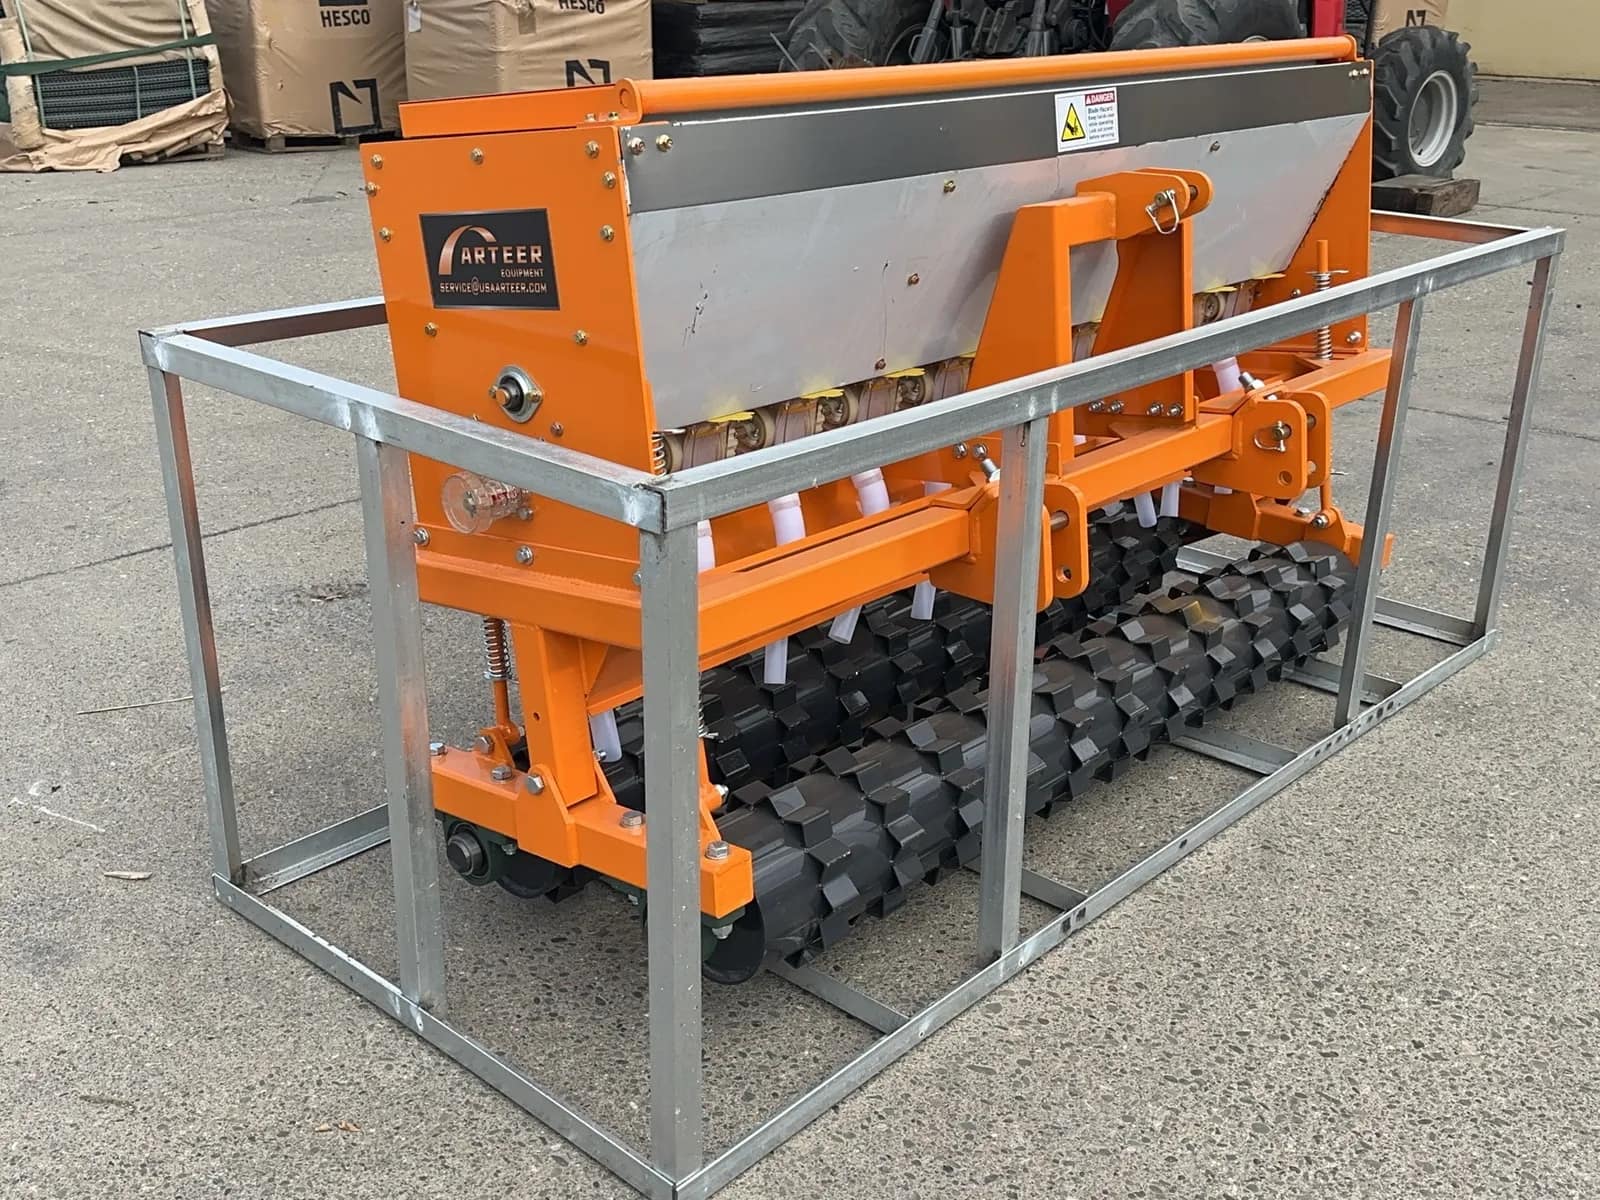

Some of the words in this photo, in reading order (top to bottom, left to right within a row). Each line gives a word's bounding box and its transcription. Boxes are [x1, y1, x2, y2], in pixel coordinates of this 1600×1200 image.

[559, 0, 605, 14] HESCO
[320, 9, 371, 28] HESCO
[1091, 93, 1114, 104] DANGER
[461, 245, 543, 264] ARTEER
[500, 268, 544, 277] EQUIPMENT
[440, 277, 547, 295] SERVICE@USAARTEER.COM
